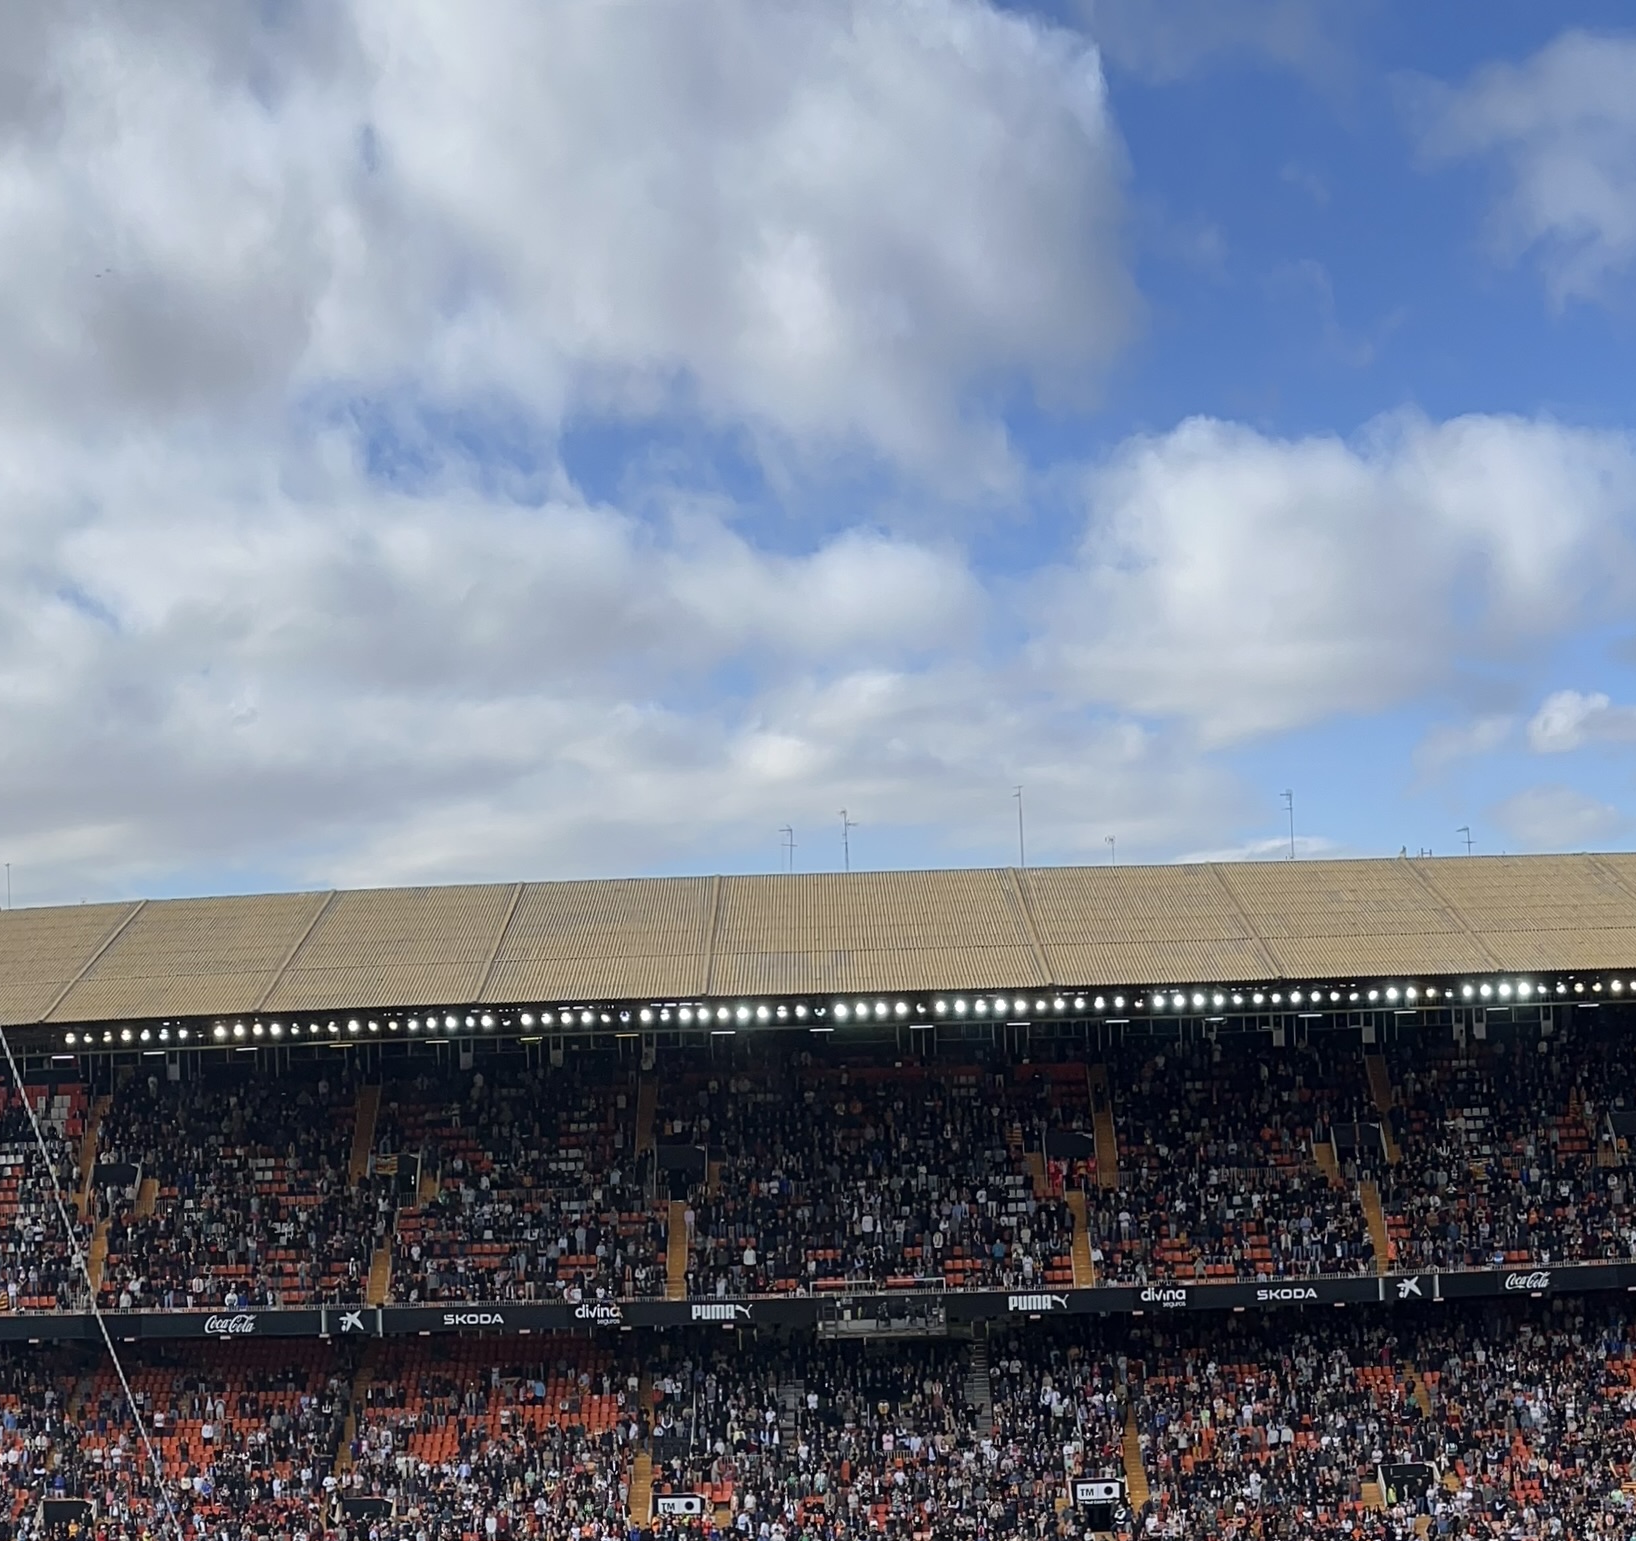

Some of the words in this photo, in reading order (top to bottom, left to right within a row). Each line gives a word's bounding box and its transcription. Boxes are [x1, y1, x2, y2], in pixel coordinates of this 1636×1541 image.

[1140, 1287, 1187, 1302] divina
[1008, 1294, 1052, 1311] PUMA
[691, 1304, 736, 1320] PUMA
[1079, 1488, 1094, 1497] TM
